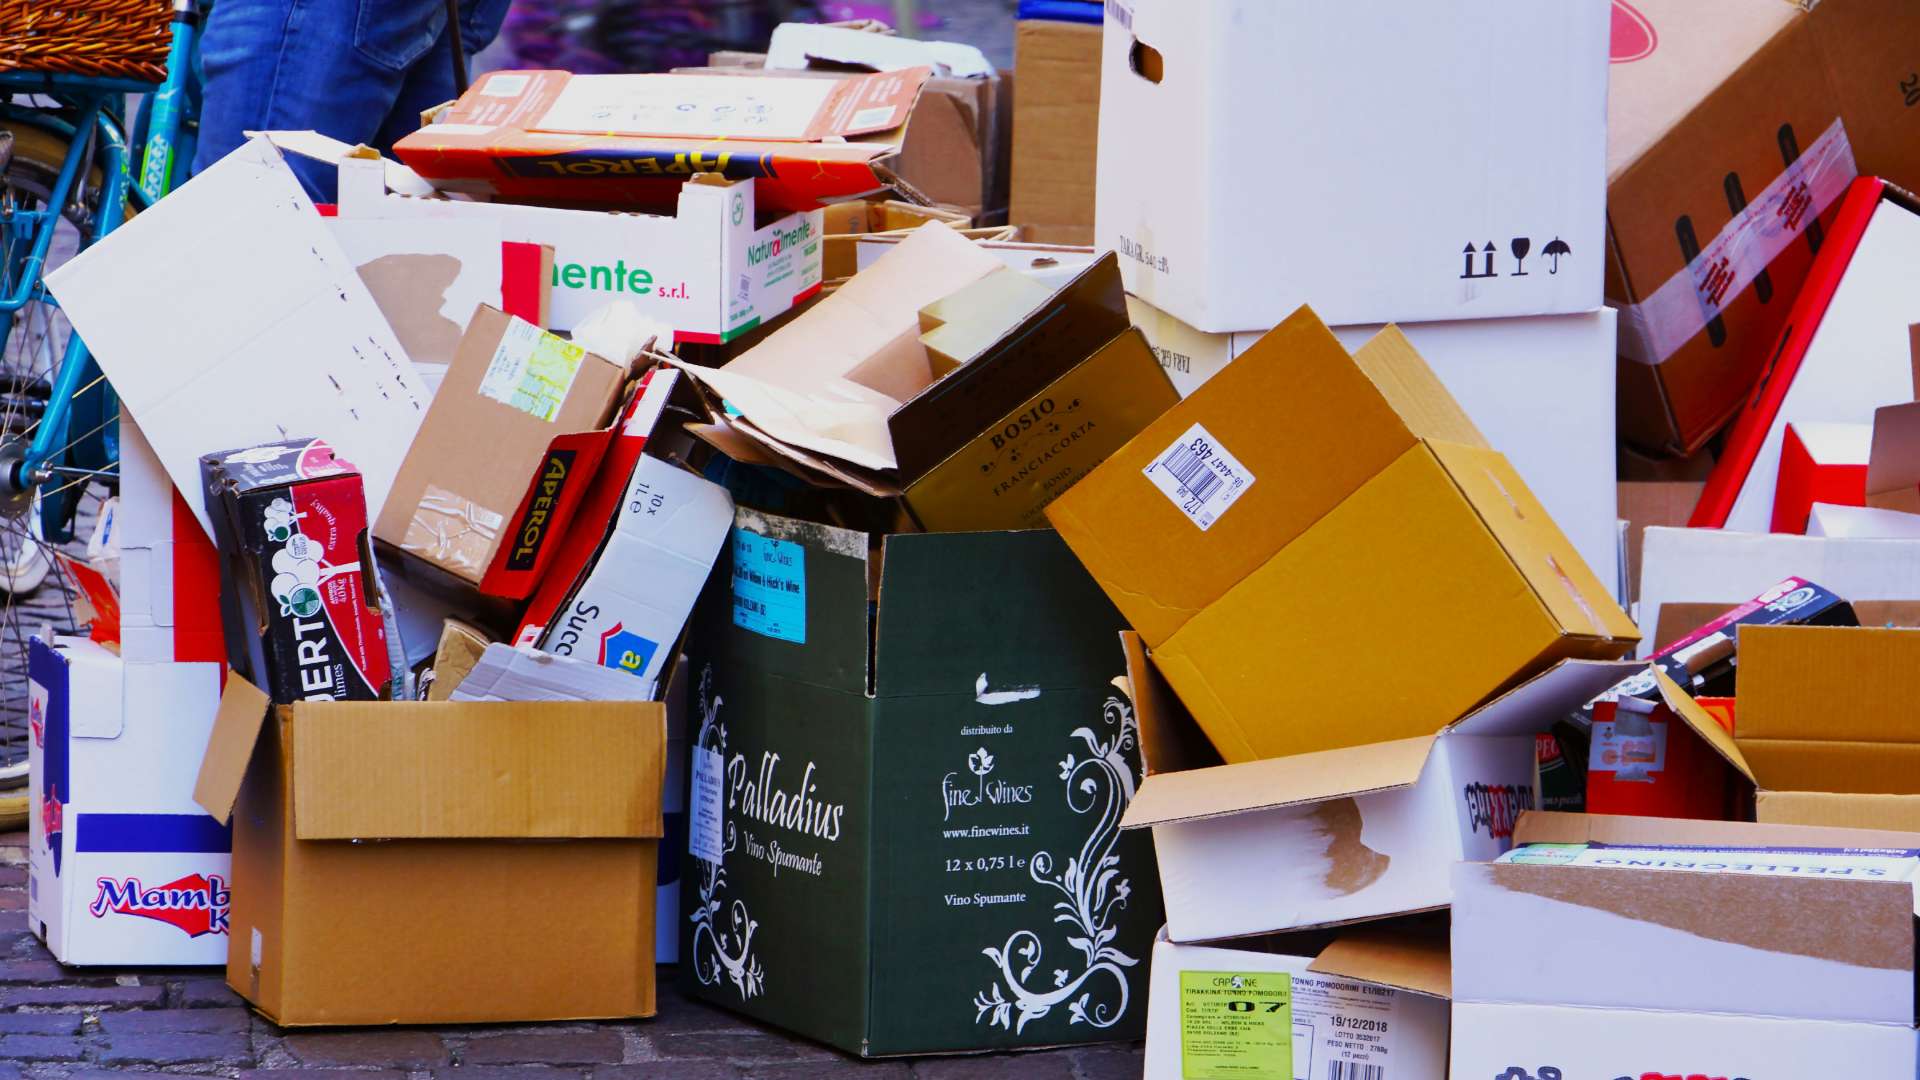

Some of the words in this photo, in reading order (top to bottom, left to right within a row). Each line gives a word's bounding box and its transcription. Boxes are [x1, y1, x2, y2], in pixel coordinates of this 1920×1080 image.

[537, 151, 733, 176] APEROL
[747, 223, 810, 266] Naturalmente
[659, 283, 690, 299] s.r.l.
[990, 398, 1055, 450] BOSIO
[993, 421, 1096, 497] FRANCIACORTA
[1190, 438, 1213, 460] 463
[310, 499, 337, 528] quality
[515, 457, 566, 561] APEROL
[555, 601, 600, 656] Succ
[960, 725, 1002, 736] distribuito
[1003, 724, 1013, 735] da
[727, 750, 844, 842] Palladius
[943, 824, 1030, 838] www.finewines.it
[744, 831, 765, 860] Vino
[766, 840, 822, 877] Spumante
[945, 859, 961, 872] 12
[965, 861, 973, 871] x
[977, 857, 1005, 872] 0,75
[944, 894, 971, 906] Vino
[973, 892, 1027, 907] Spumante
[1330, 1015, 1388, 1033] 19/12/2018
[1335, 1031, 1353, 1040] LOTTO
[1327, 1039, 1342, 1048] PESO
[1344, 1041, 1364, 1050] NETTO
